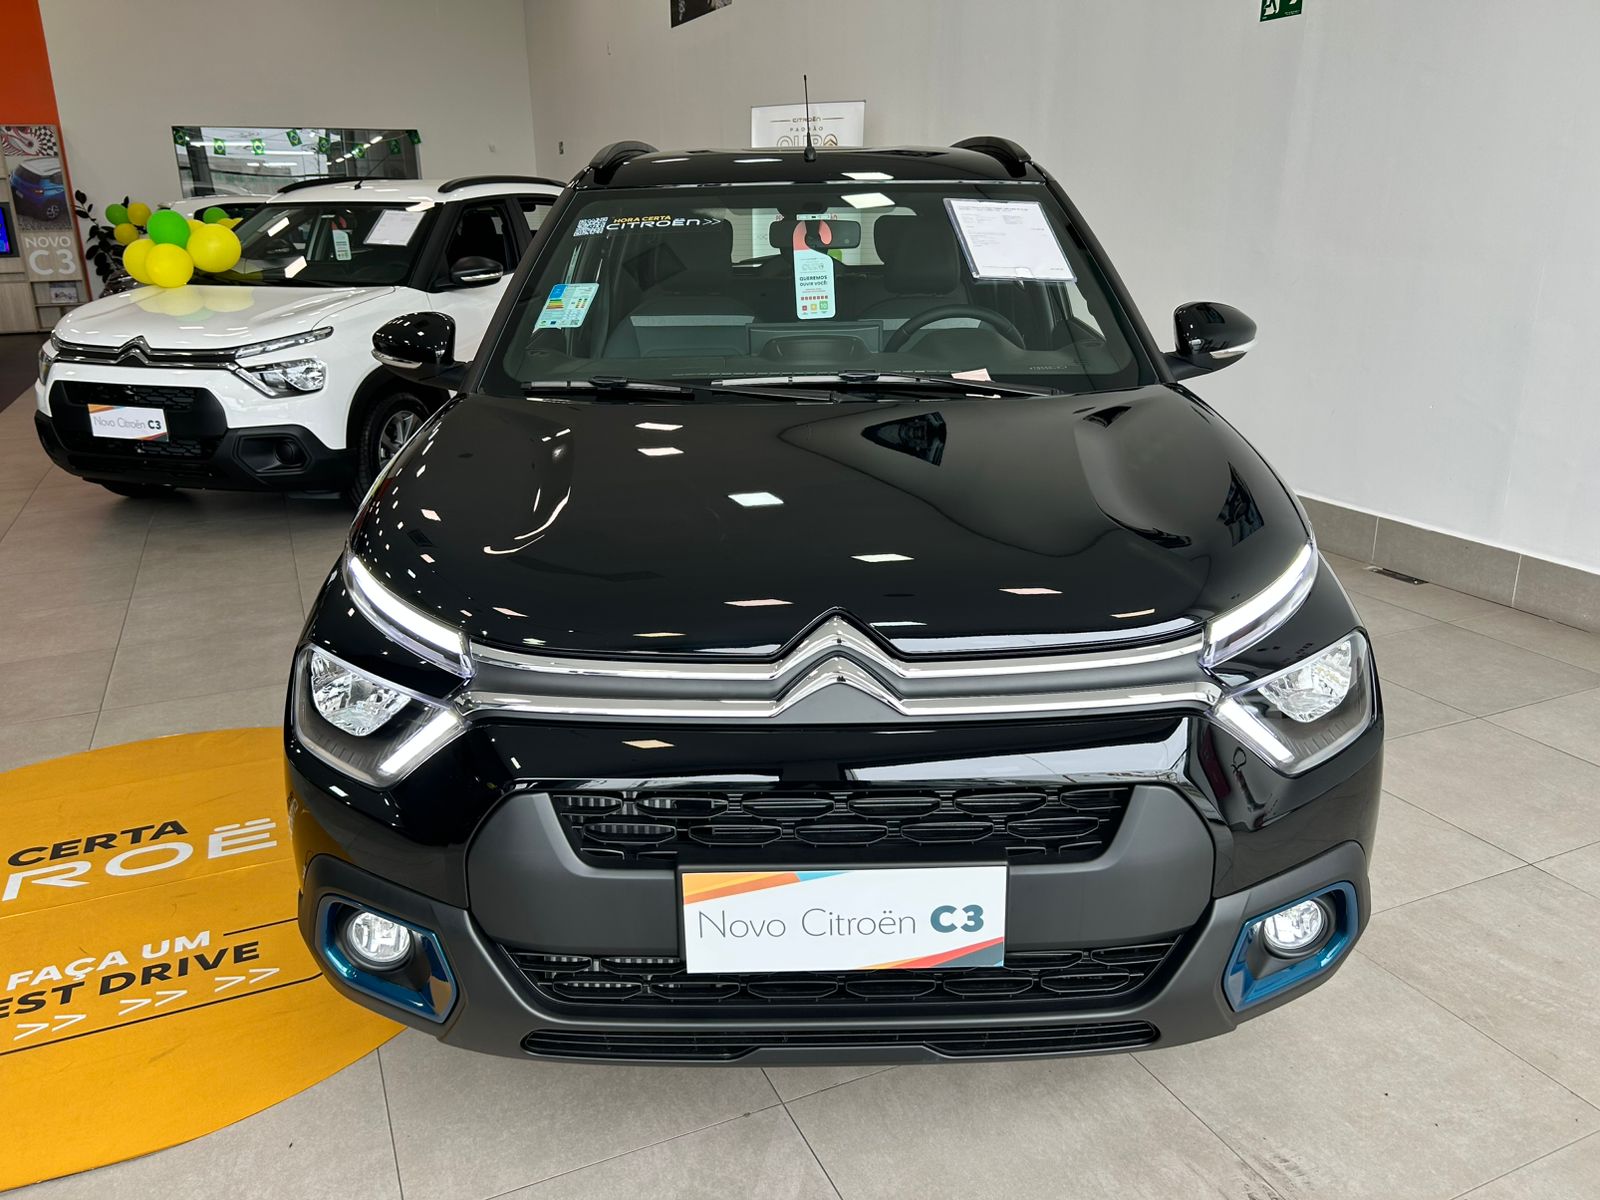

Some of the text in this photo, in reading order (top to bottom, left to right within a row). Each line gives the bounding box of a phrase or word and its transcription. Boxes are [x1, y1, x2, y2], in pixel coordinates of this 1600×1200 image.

[613, 214, 672, 224] HORA CERTA
[24, 235, 71, 248] NOVO
[29, 248, 76, 275] C3
[93, 415, 162, 430] Novo Citroën C3
[7, 819, 189, 867] CERTA
[698, 903, 985, 939] Novo Citroën C3
[6, 930, 211, 991] FAÇA UM
[99, 940, 260, 996] DRIVE
